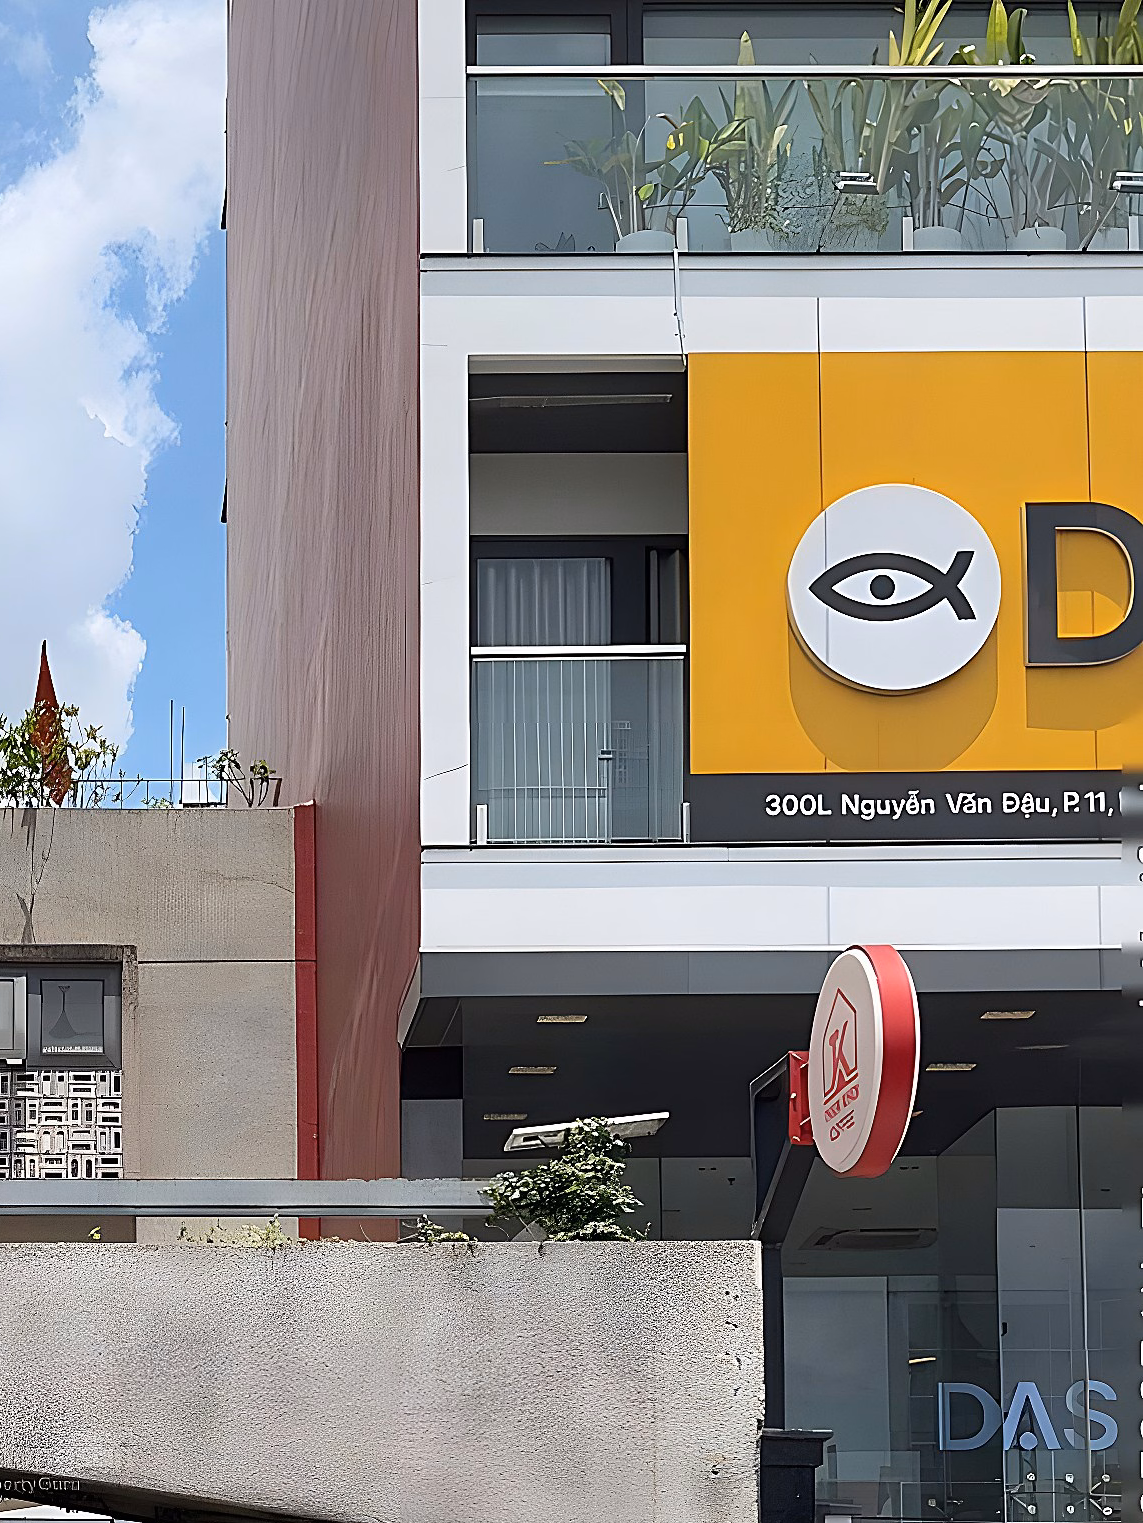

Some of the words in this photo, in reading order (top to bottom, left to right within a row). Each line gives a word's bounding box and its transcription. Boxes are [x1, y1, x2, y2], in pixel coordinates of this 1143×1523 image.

[764, 793, 833, 817] 300L
[840, 789, 936, 821] Nguyễn
[1001, 792, 1059, 820] Đậu,
